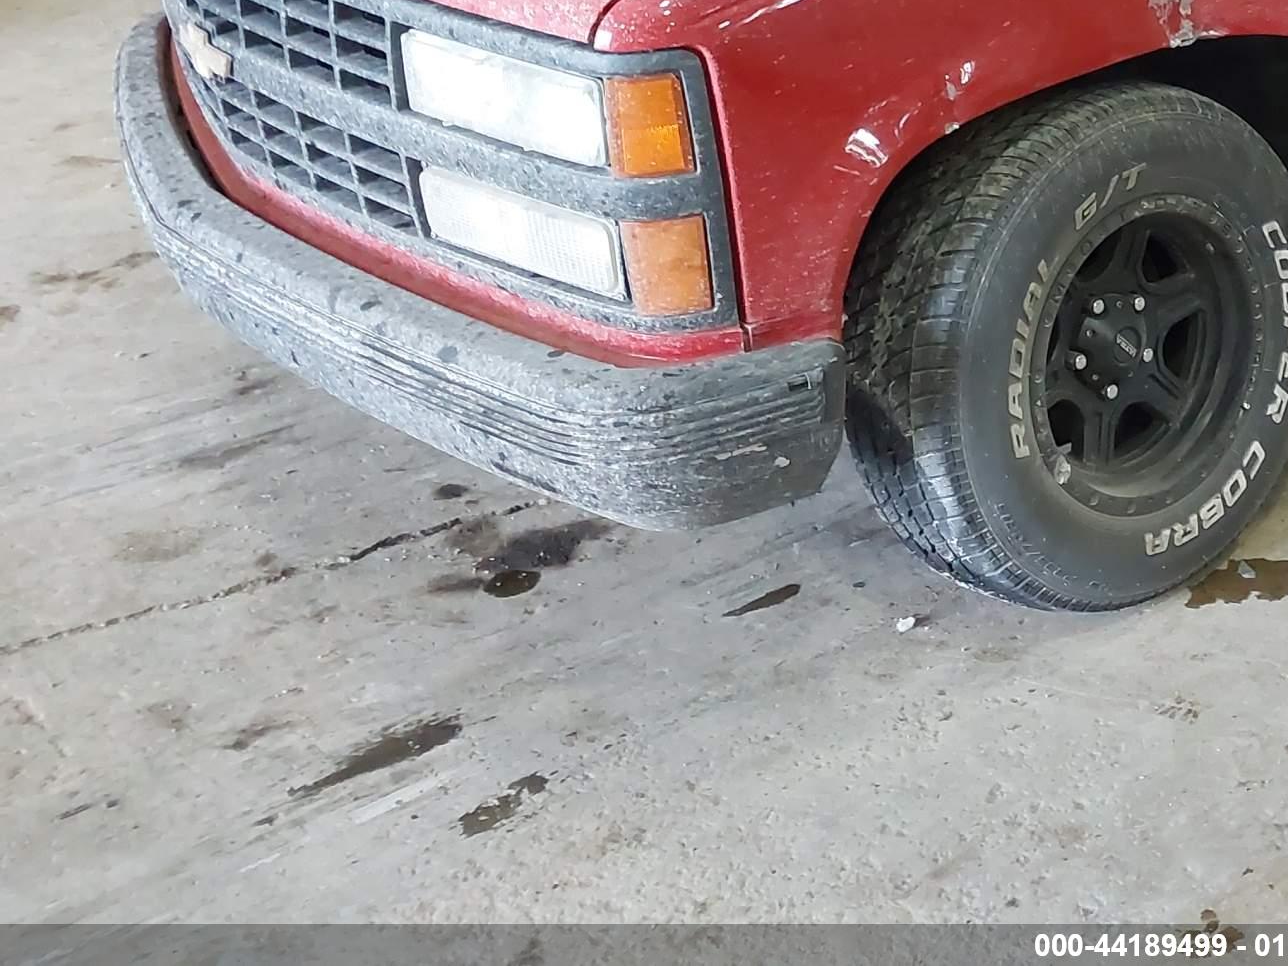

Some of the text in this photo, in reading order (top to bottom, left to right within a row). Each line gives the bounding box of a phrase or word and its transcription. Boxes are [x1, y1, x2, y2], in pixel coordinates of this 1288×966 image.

[1008, 258, 1051, 460] RADIAL
[1074, 162, 1148, 231] G/T
[1144, 439, 1267, 556] COBRA
